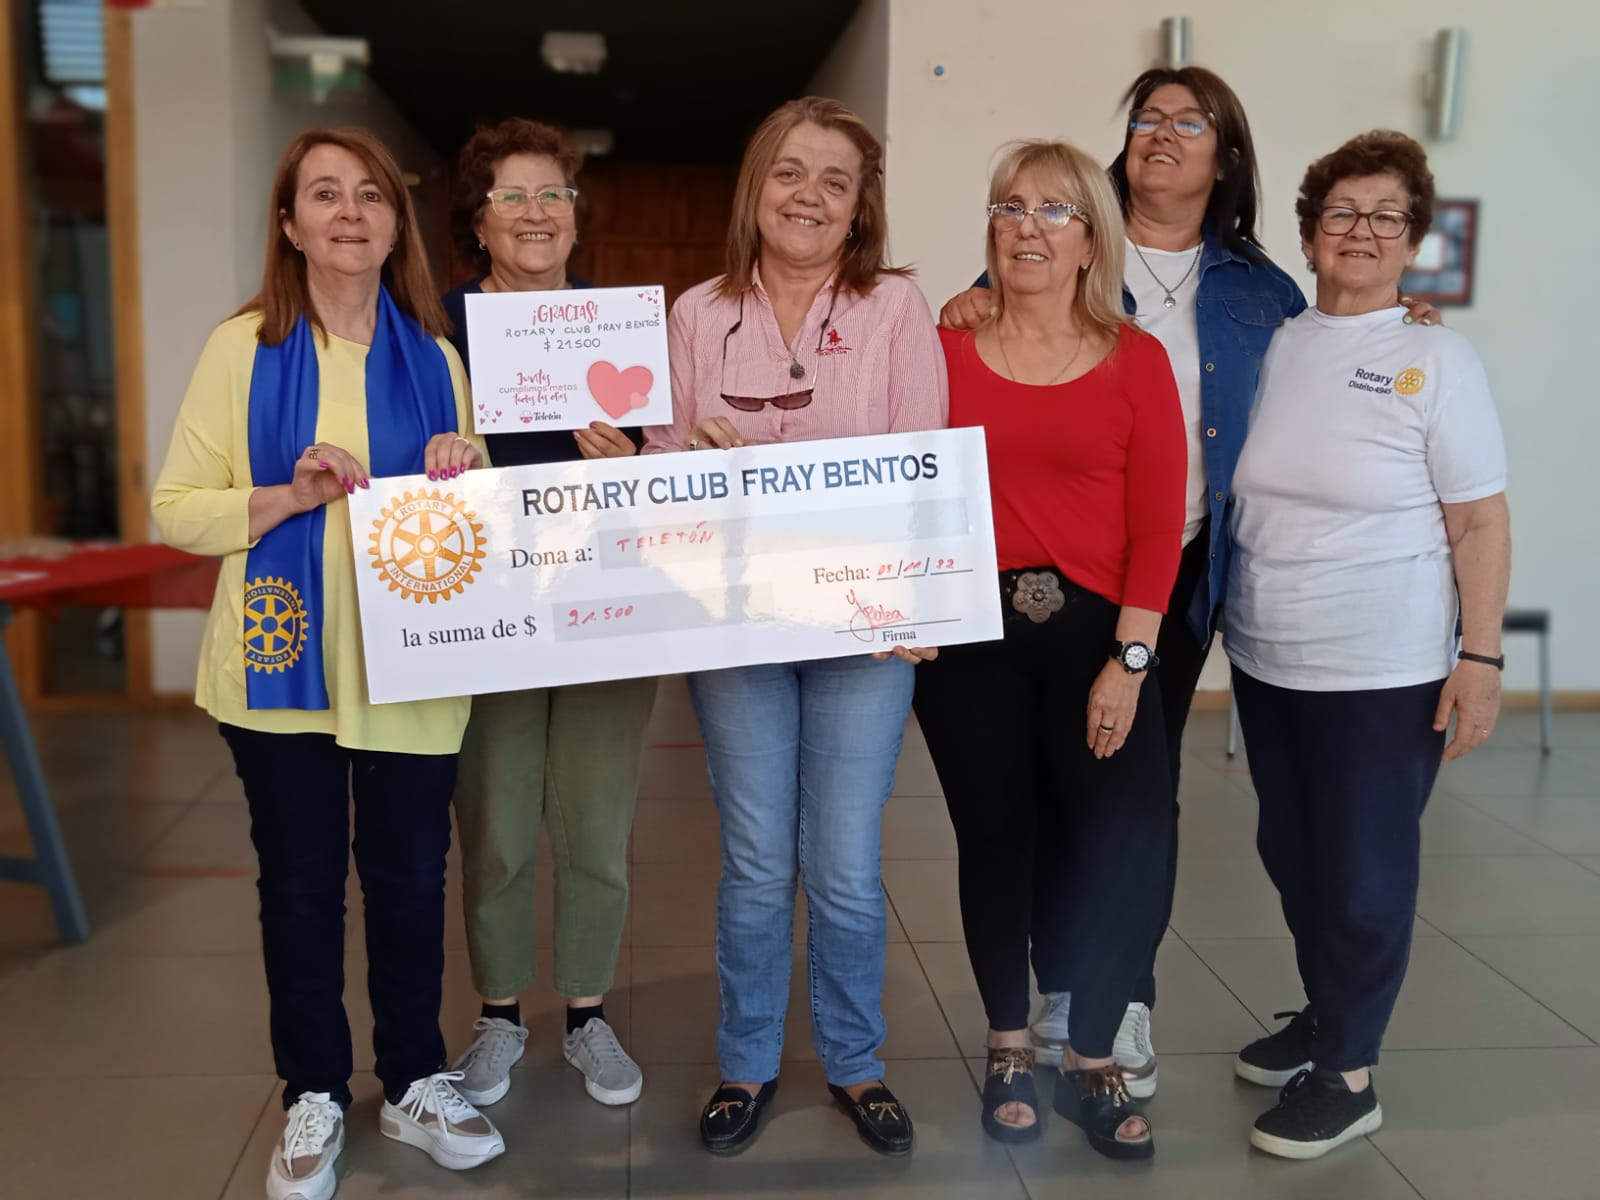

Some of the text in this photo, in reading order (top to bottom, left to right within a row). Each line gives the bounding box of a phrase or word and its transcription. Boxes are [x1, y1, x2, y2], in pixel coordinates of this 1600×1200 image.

[532, 301, 598, 324] ¡GRACIAS!
[506, 319, 660, 338] ROTARY CLUB FRAY BENTOS
[543, 337, 551, 352] $
[1348, 380, 1374, 392] Distrito
[1355, 368, 1393, 386] Rotary
[499, 384, 578, 394] cumplimos metas
[522, 452, 938, 516] ROTARY CLUB FRAY BENTOS
[399, 501, 449, 517] ROTARY
[509, 547, 593, 569] Dona a:
[390, 560, 472, 592] INTERNATIONAL
[813, 565, 870, 584] Fecha:
[401, 615, 537, 648] la suma de $
[882, 630, 916, 642] Firma
